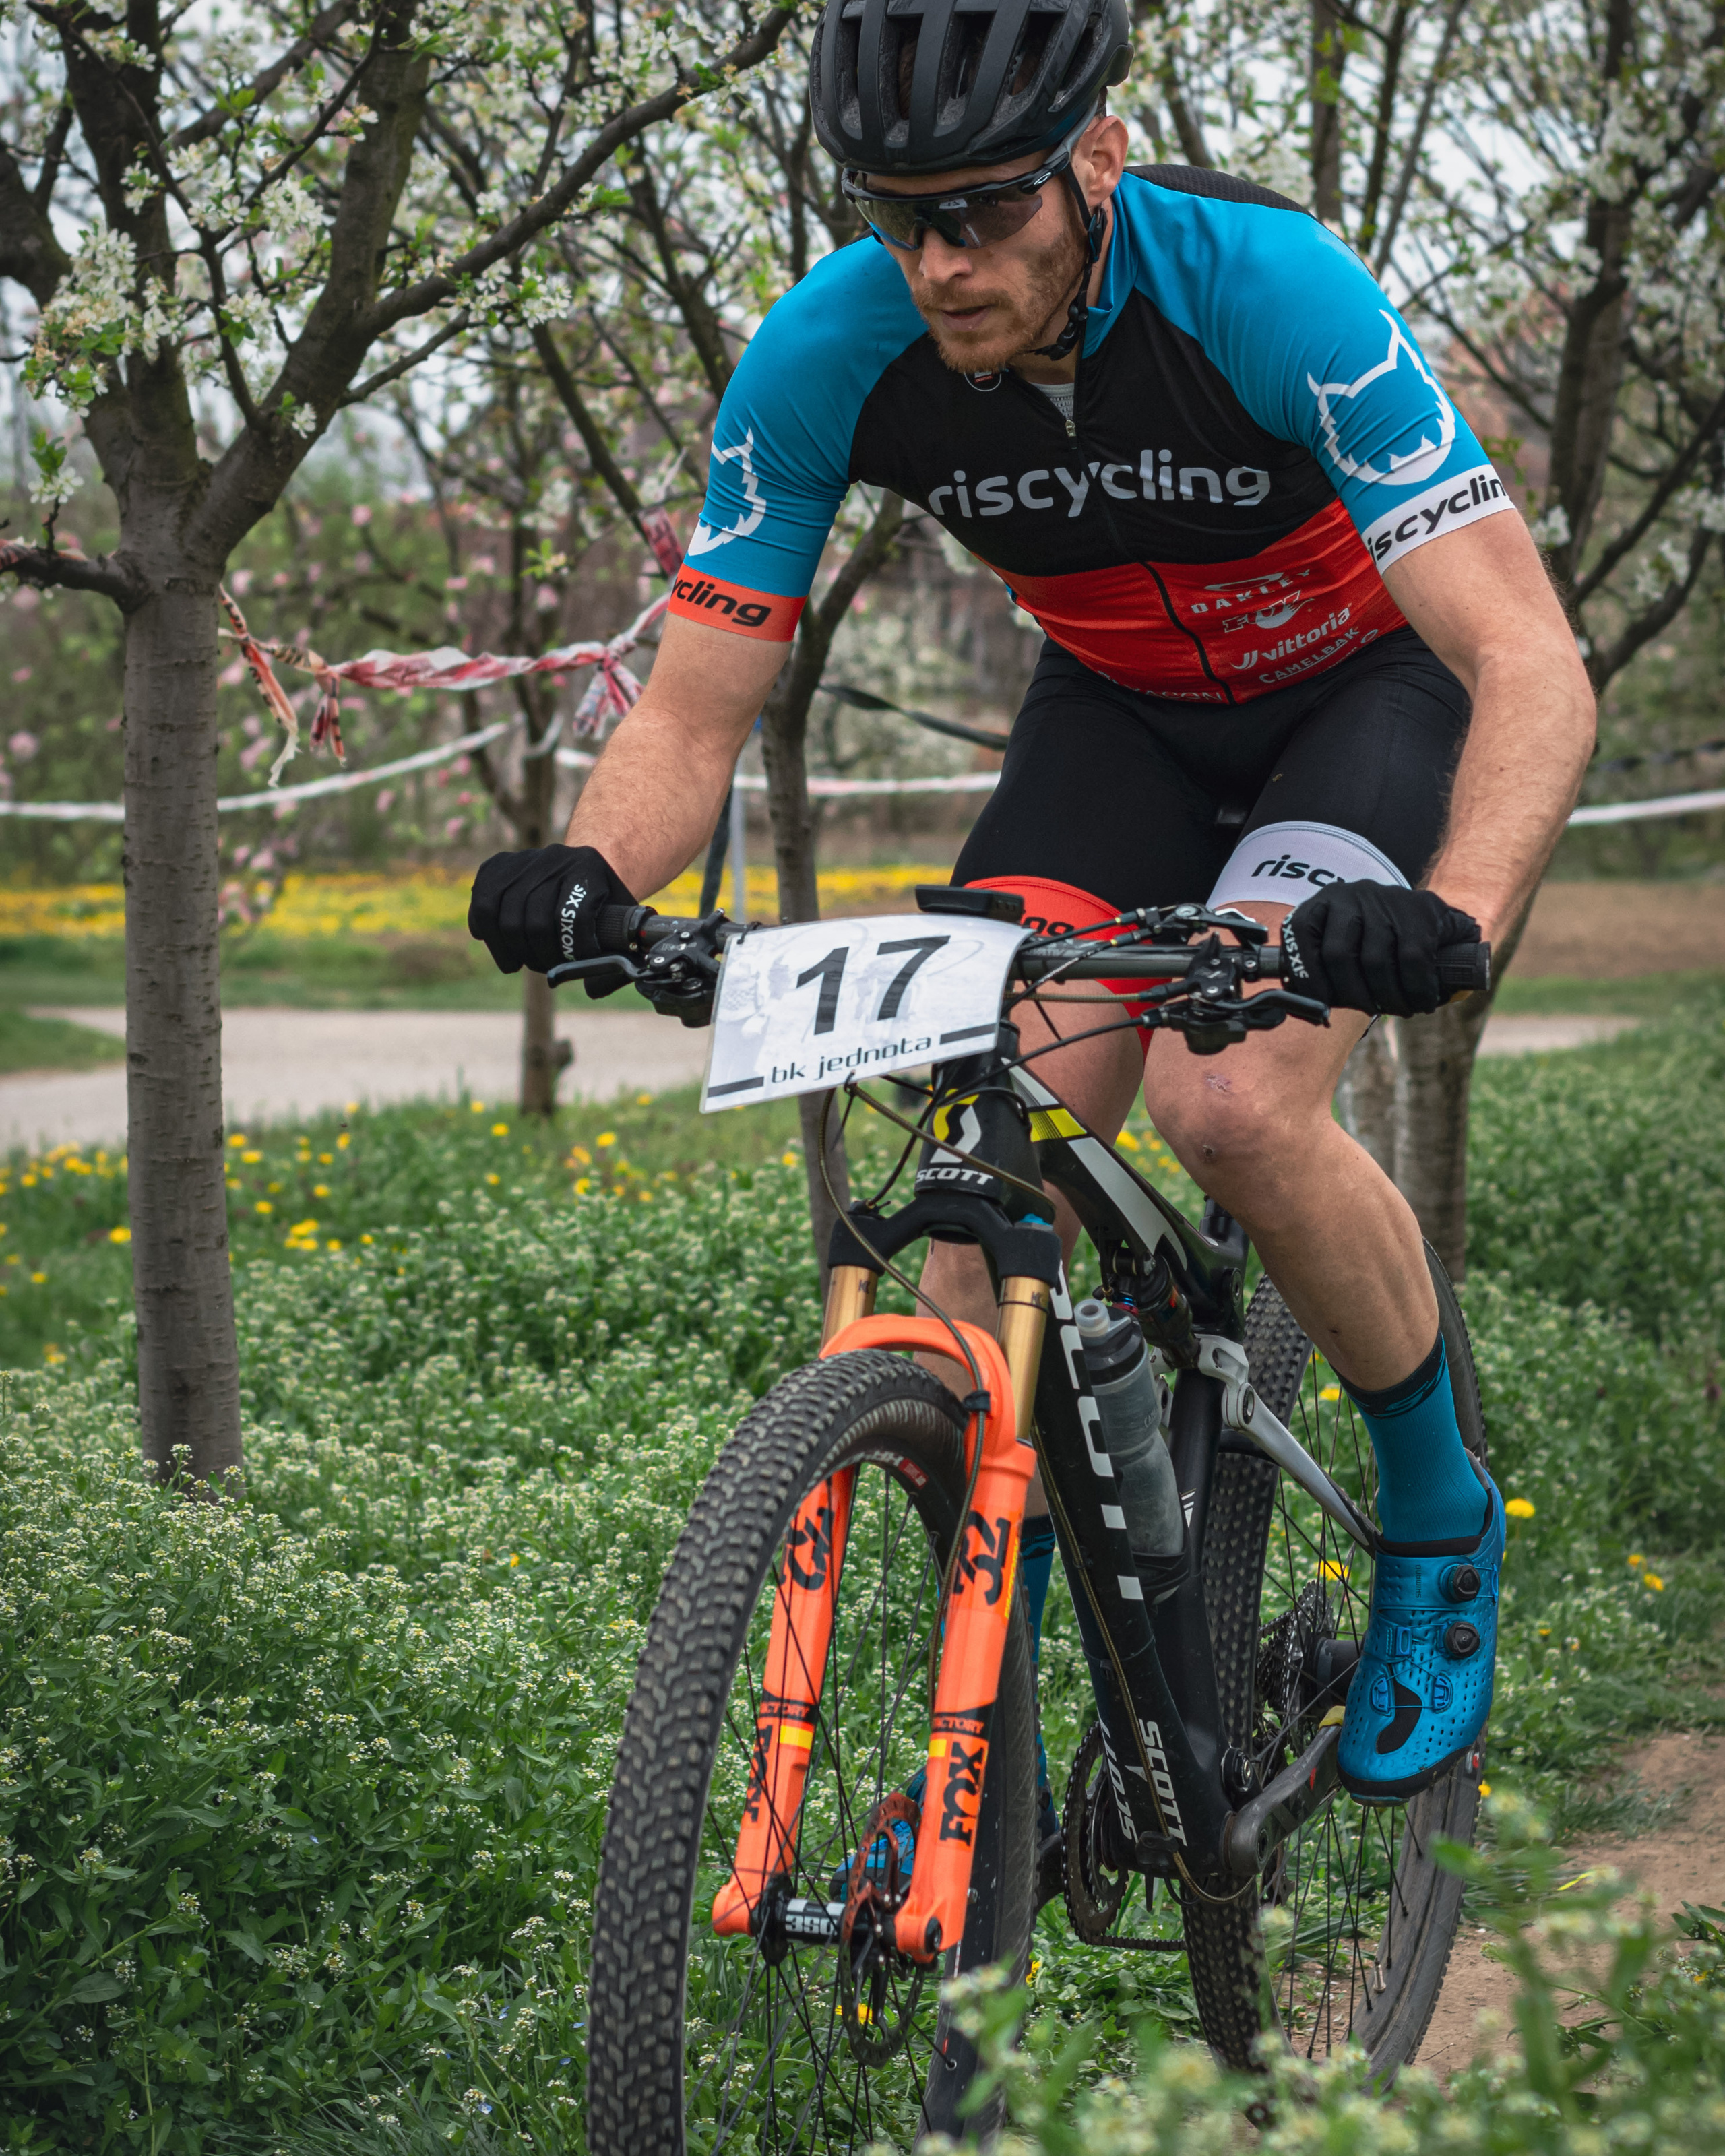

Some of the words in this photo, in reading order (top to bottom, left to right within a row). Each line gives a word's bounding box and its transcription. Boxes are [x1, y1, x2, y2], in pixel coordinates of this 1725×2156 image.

[929, 449, 1271, 518] riscycling
[1259, 627, 1360, 683] CAMELBAK
[1261, 604, 1352, 661] vittoria
[1251, 854, 1346, 887] risc
[796, 935, 951, 1036] 17
[772, 1062, 806, 1083] bk
[814, 1036, 931, 1081] jednota
[916, 1168, 994, 1186] SCOTT
[939, 1741, 984, 1847] FOX
[1138, 1718, 1188, 1847] SCOTT
[785, 1913, 838, 1936] 350
